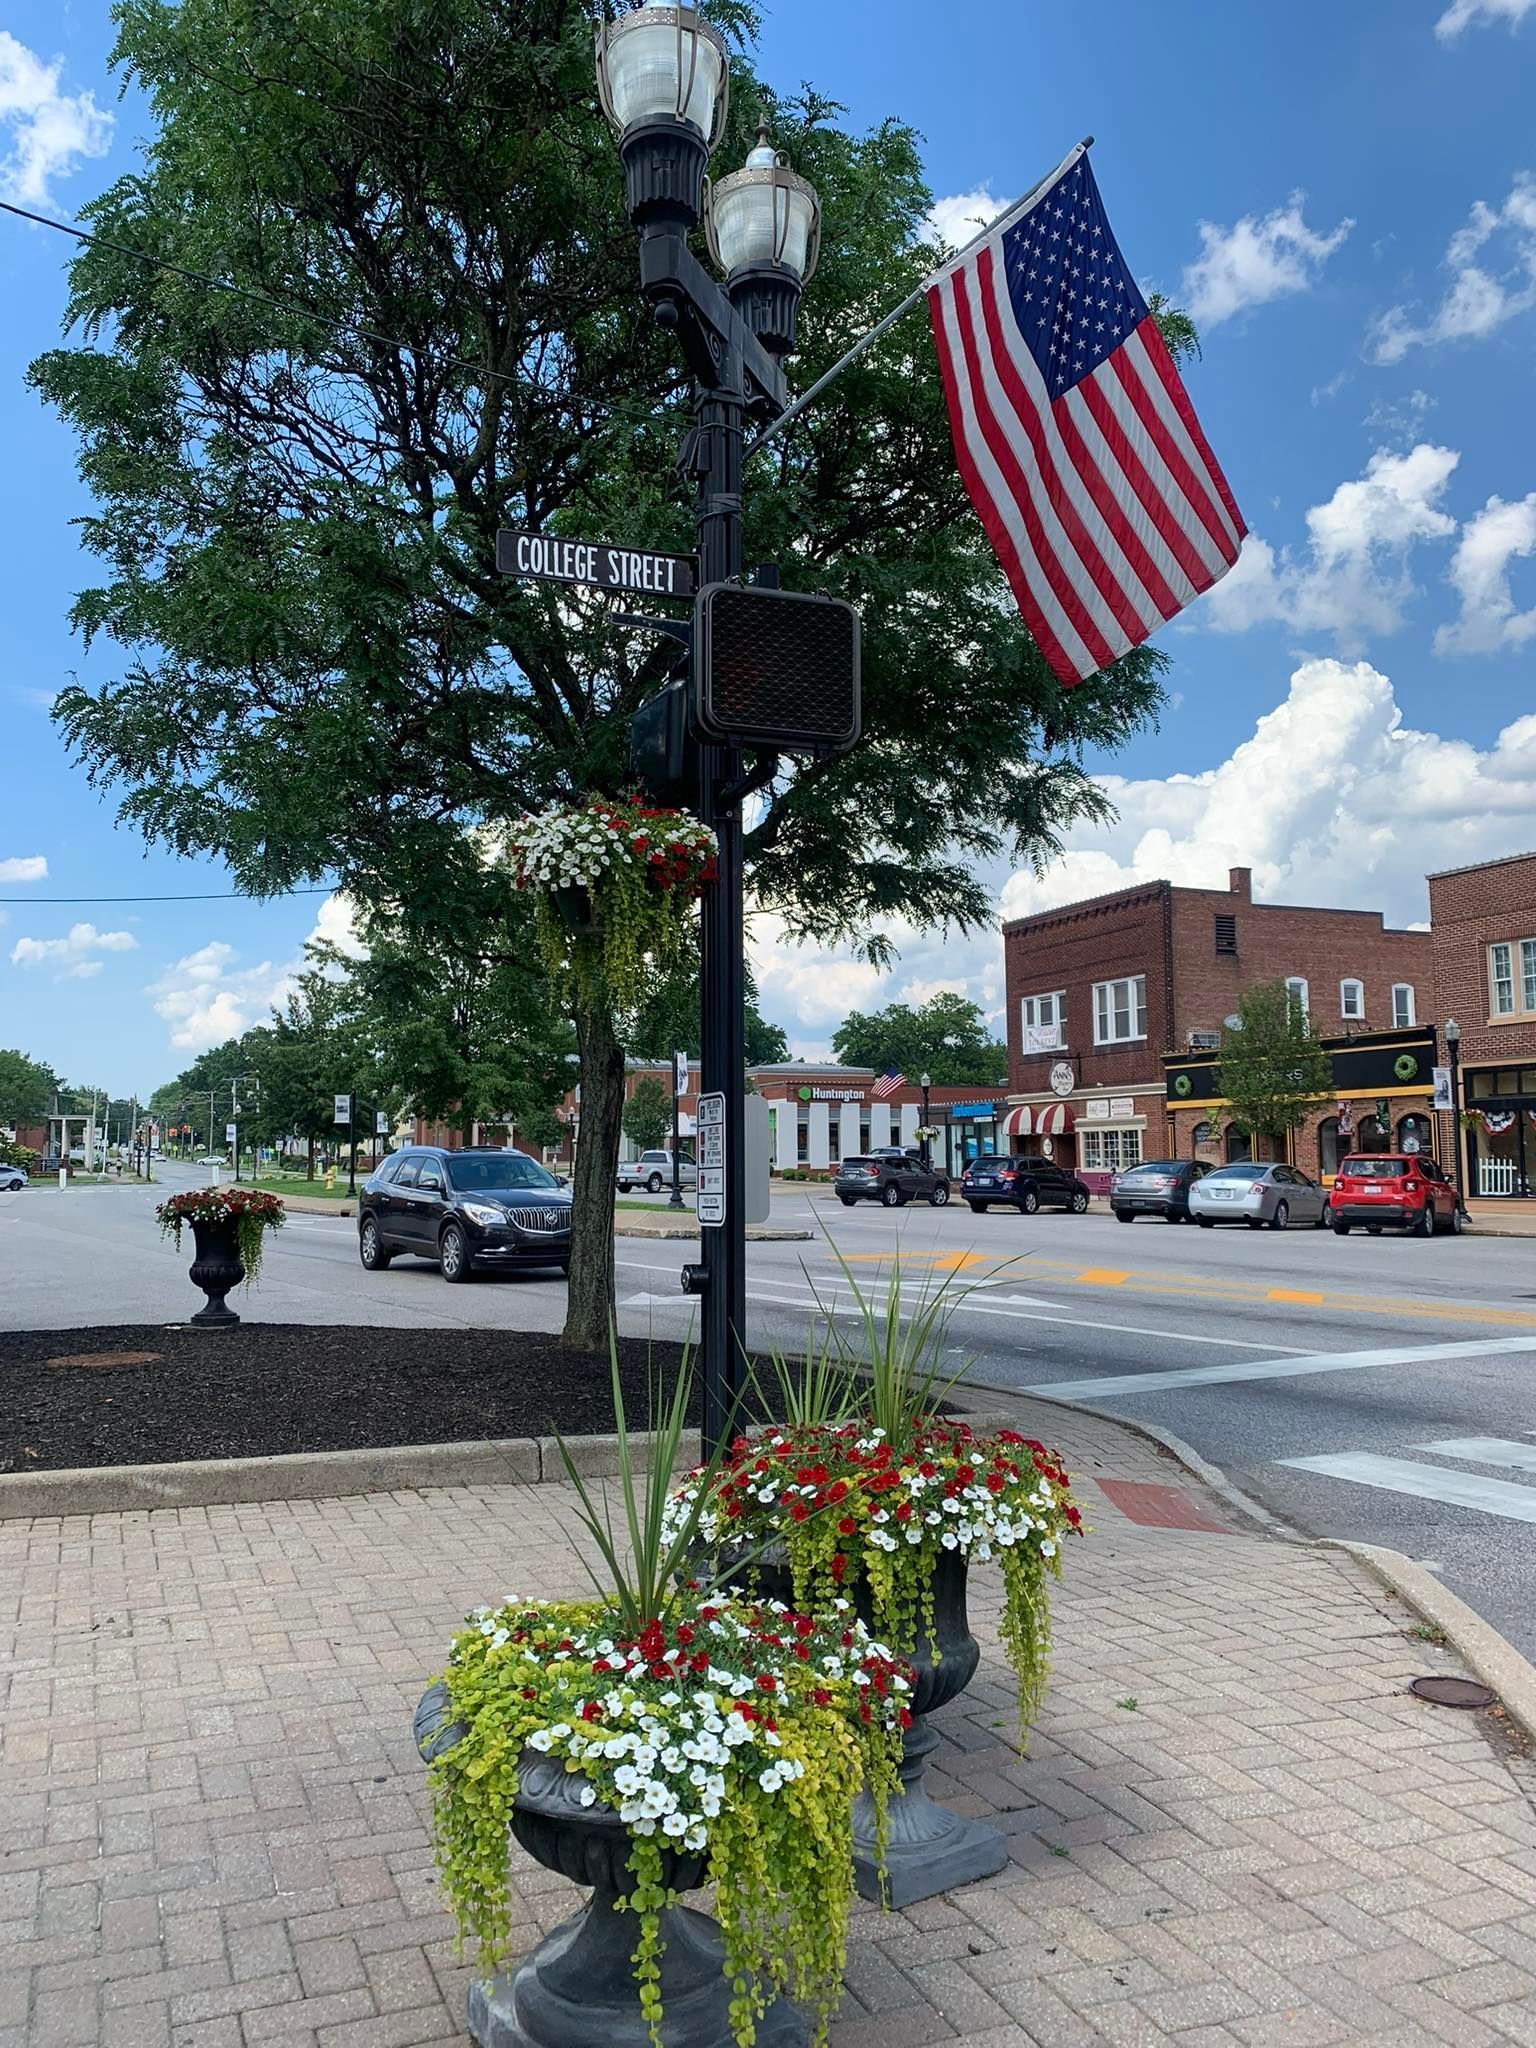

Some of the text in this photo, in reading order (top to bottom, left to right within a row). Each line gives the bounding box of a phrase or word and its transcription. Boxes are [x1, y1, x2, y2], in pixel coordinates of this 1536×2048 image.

[517, 536, 676, 593] COLLEGE STREET
[812, 1087, 865, 1102] Huntington
